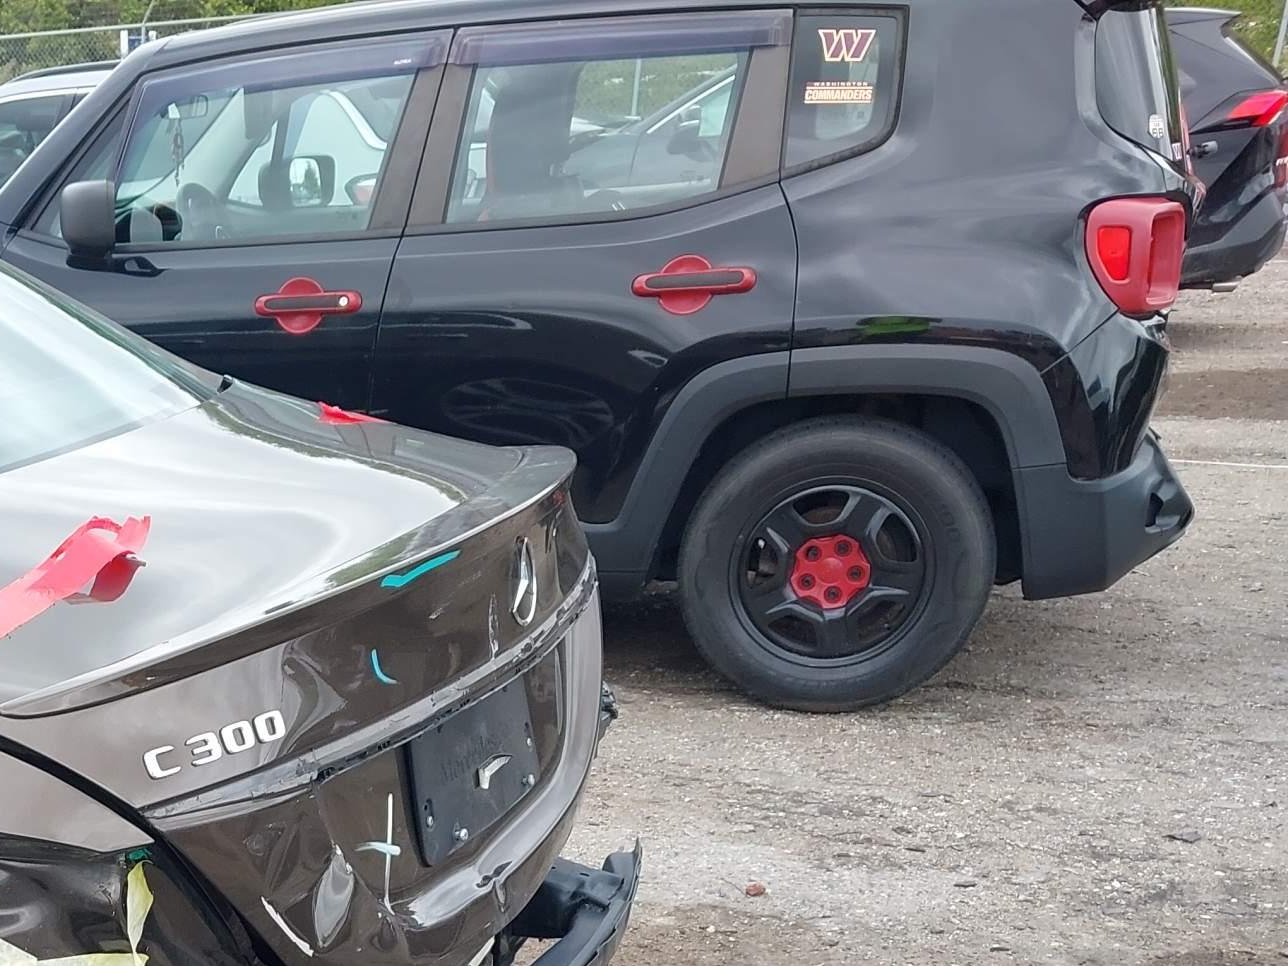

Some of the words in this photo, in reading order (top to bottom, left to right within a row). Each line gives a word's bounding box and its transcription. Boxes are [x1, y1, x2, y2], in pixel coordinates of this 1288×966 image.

[818, 29, 876, 62] W
[804, 89, 873, 101] COMMANDERS
[143, 745, 182, 780] C
[184, 710, 287, 768] 300
